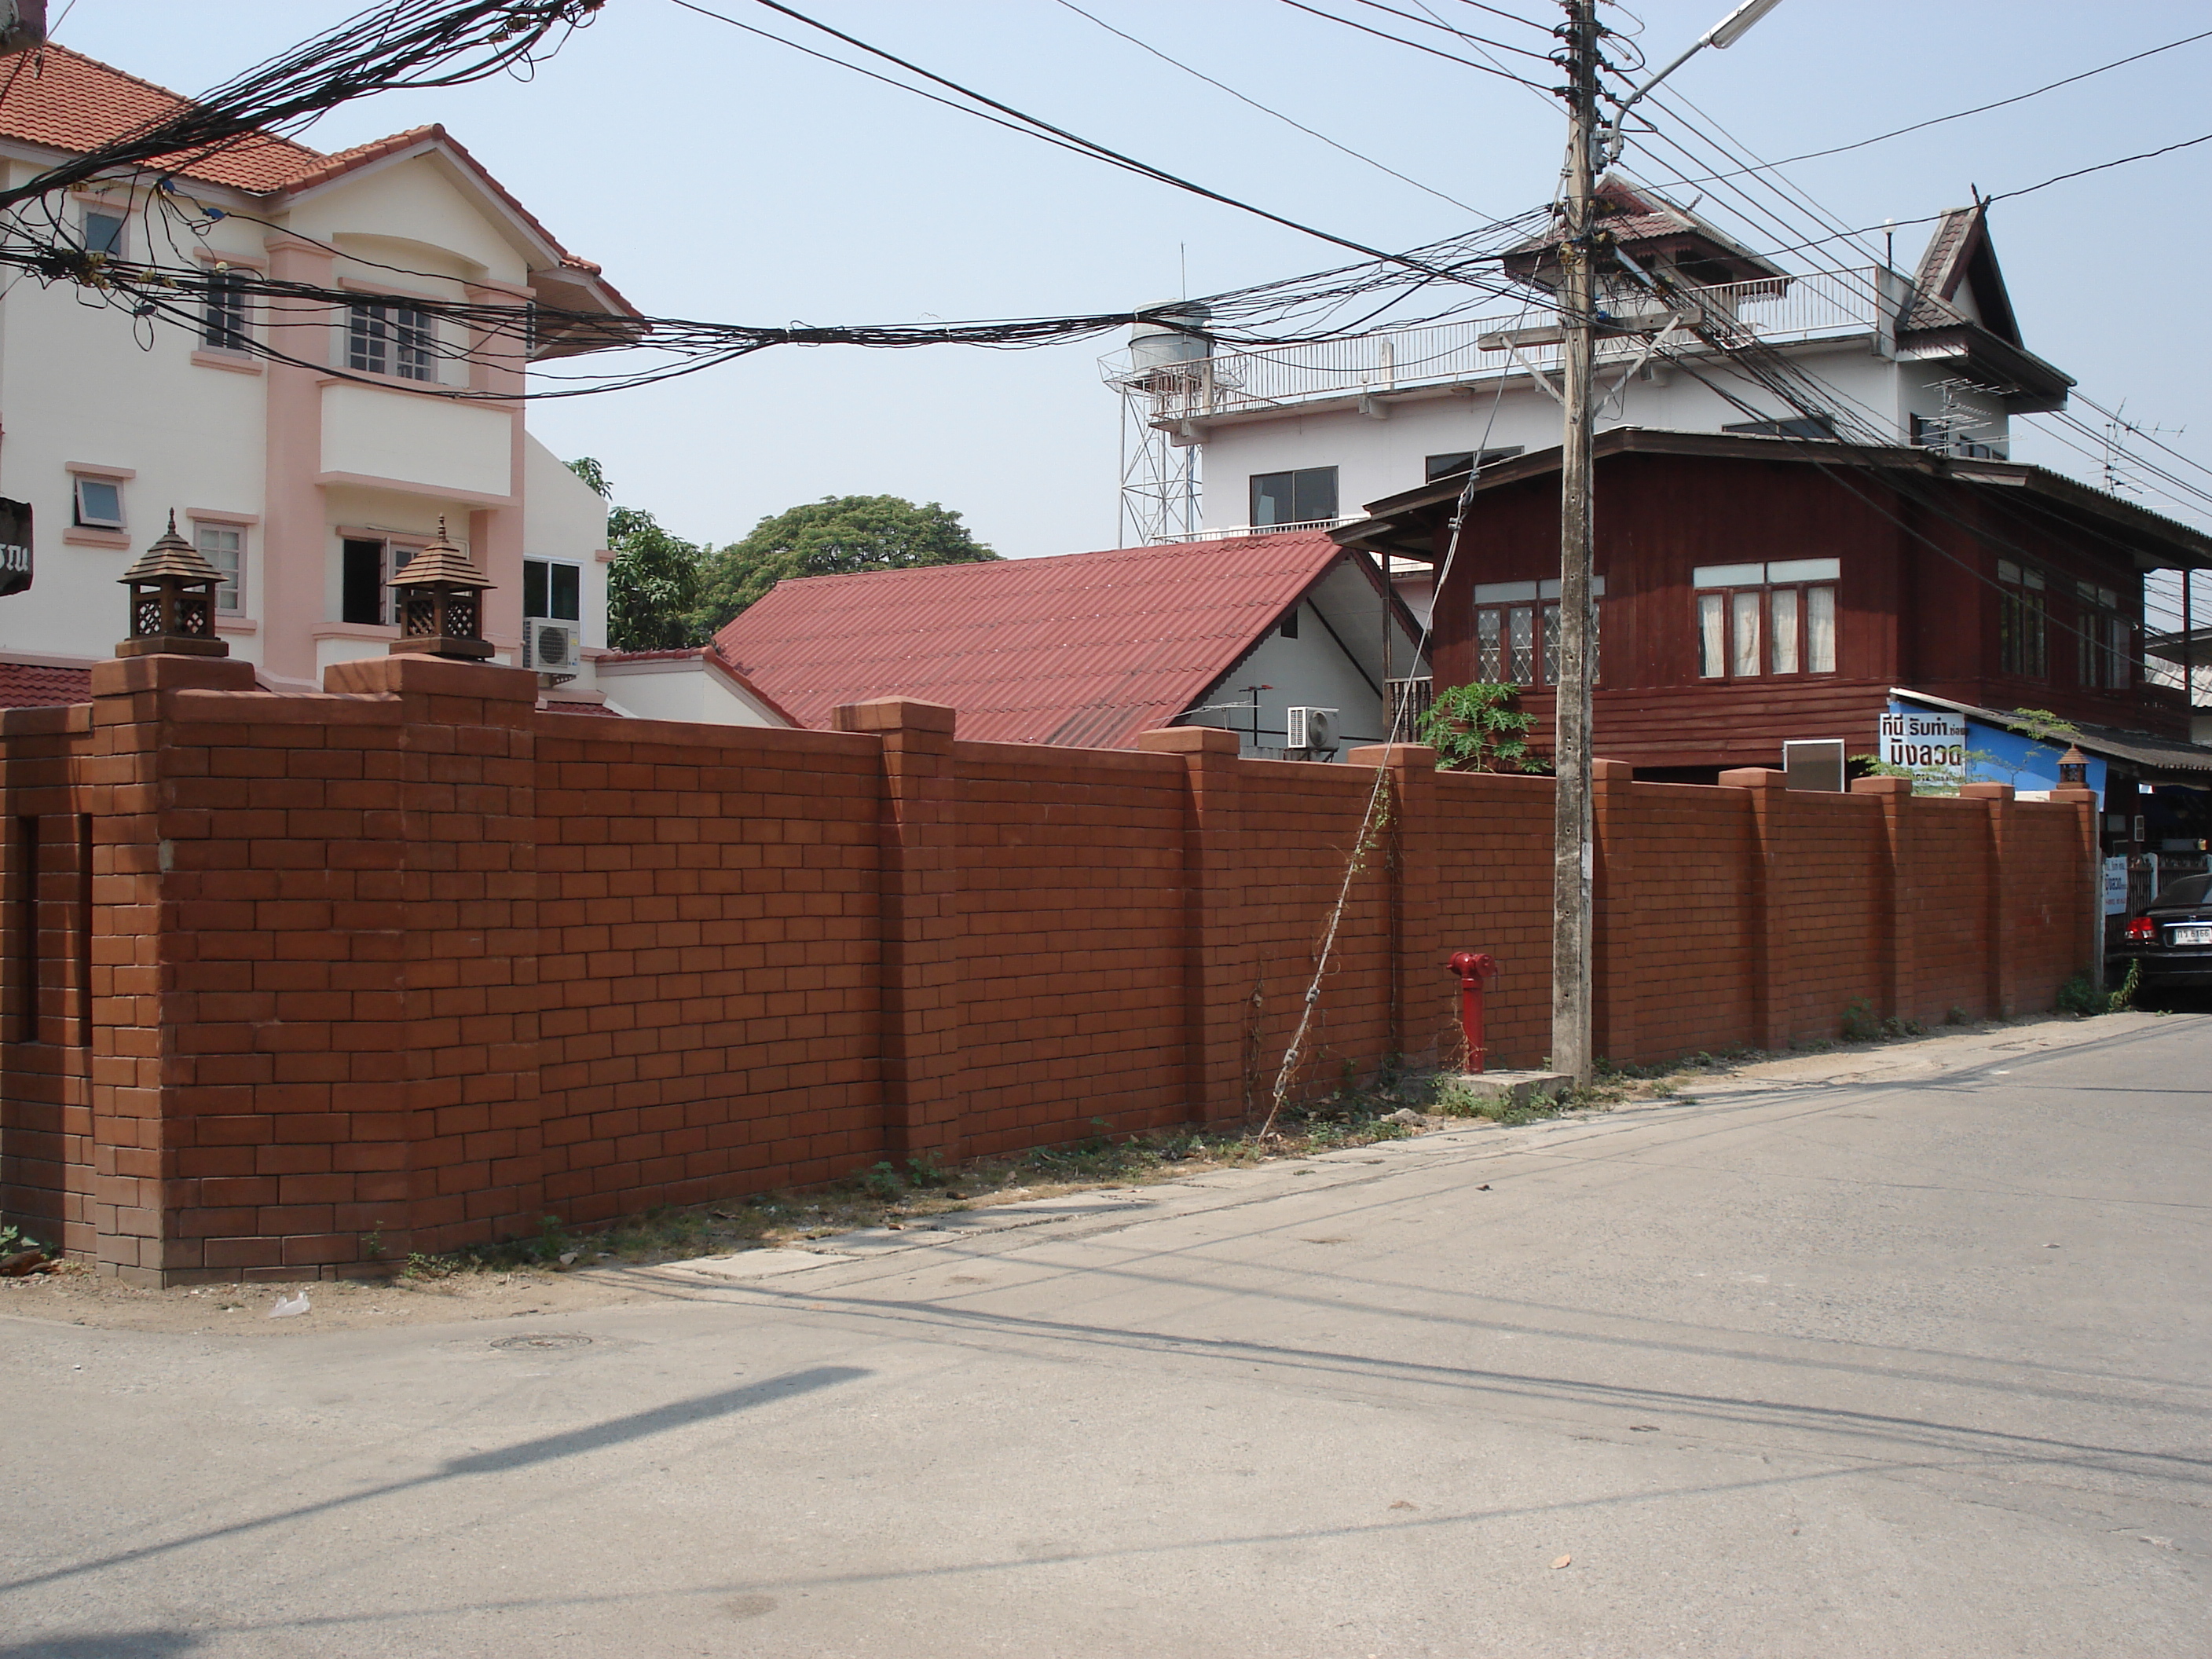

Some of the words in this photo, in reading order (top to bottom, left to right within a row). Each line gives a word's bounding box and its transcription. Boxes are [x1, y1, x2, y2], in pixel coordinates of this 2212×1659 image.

[1909, 716, 1947, 736] รับทำ
[1890, 737, 1963, 767] ม้งลวด
